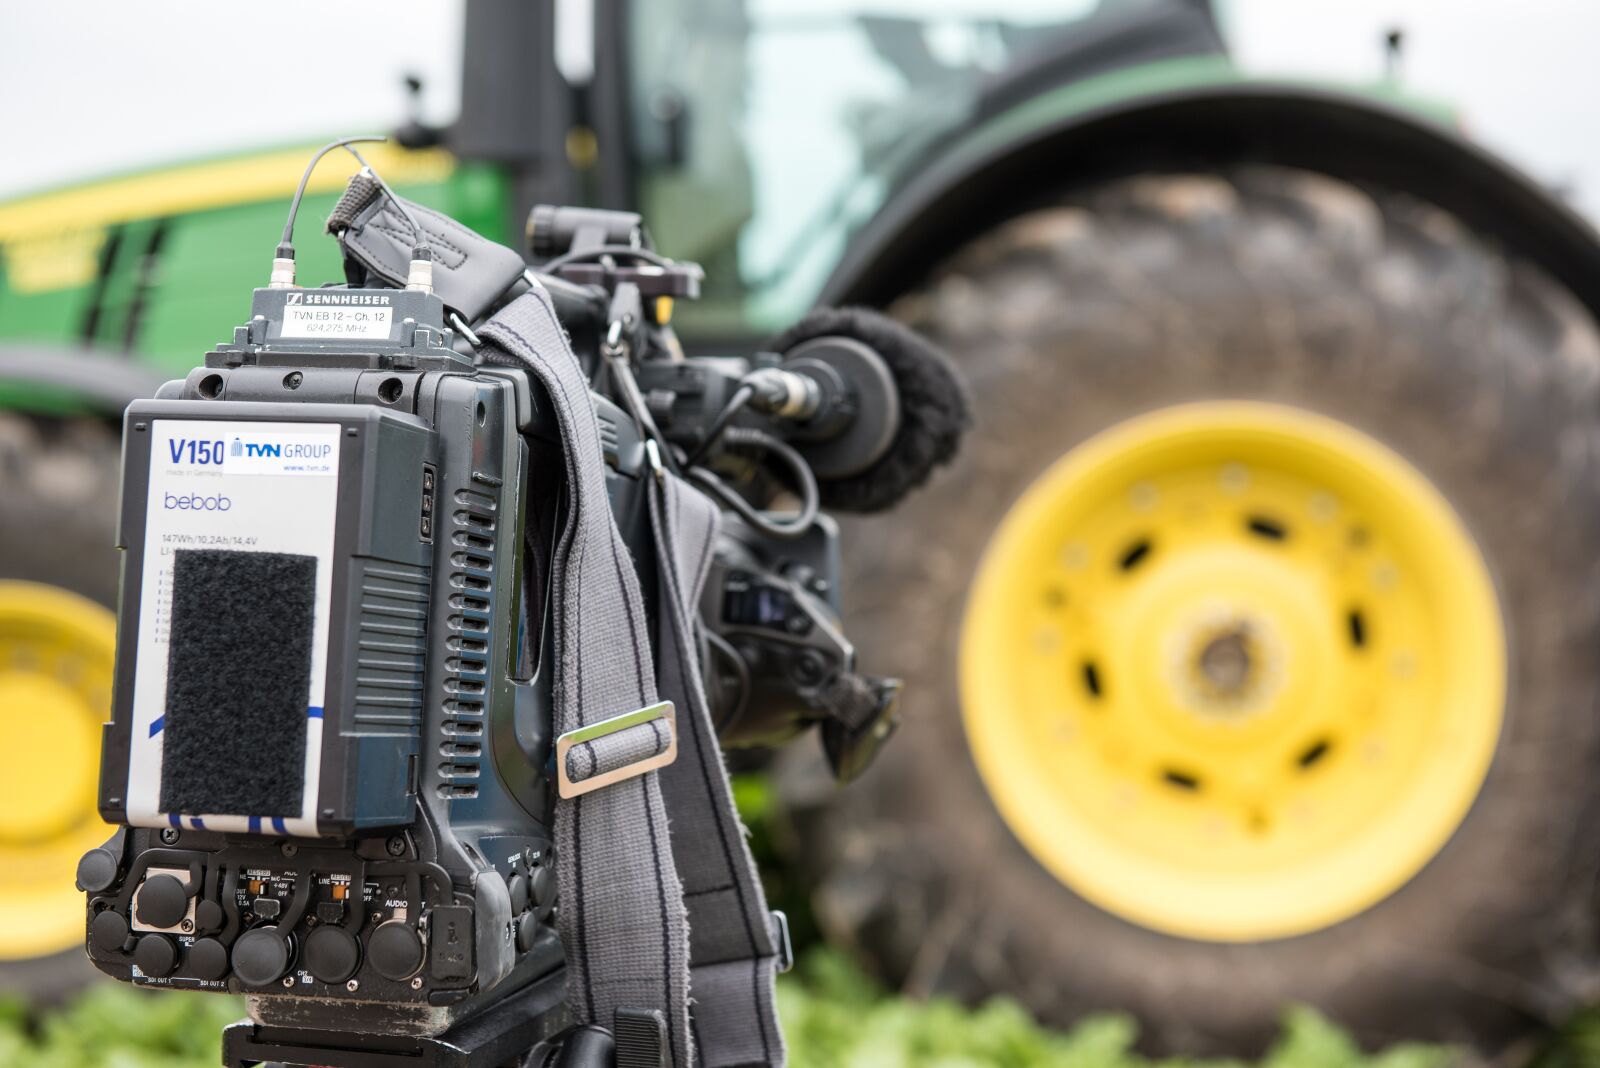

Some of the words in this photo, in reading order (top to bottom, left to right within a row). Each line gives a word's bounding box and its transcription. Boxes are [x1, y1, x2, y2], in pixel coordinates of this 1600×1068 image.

[305, 294, 390, 305] SENNHEISER
[293, 311, 313, 320] TVN
[316, 311, 329, 321] EB
[333, 312, 344, 321] 12
[374, 312, 385, 321] 12
[345, 324, 367, 333] MHz
[169, 438, 225, 465] V150
[245, 443, 281, 458] TVN
[284, 443, 331, 459] GROUP
[164, 491, 231, 511] bebob
[385, 899, 408, 908] AUDIO
